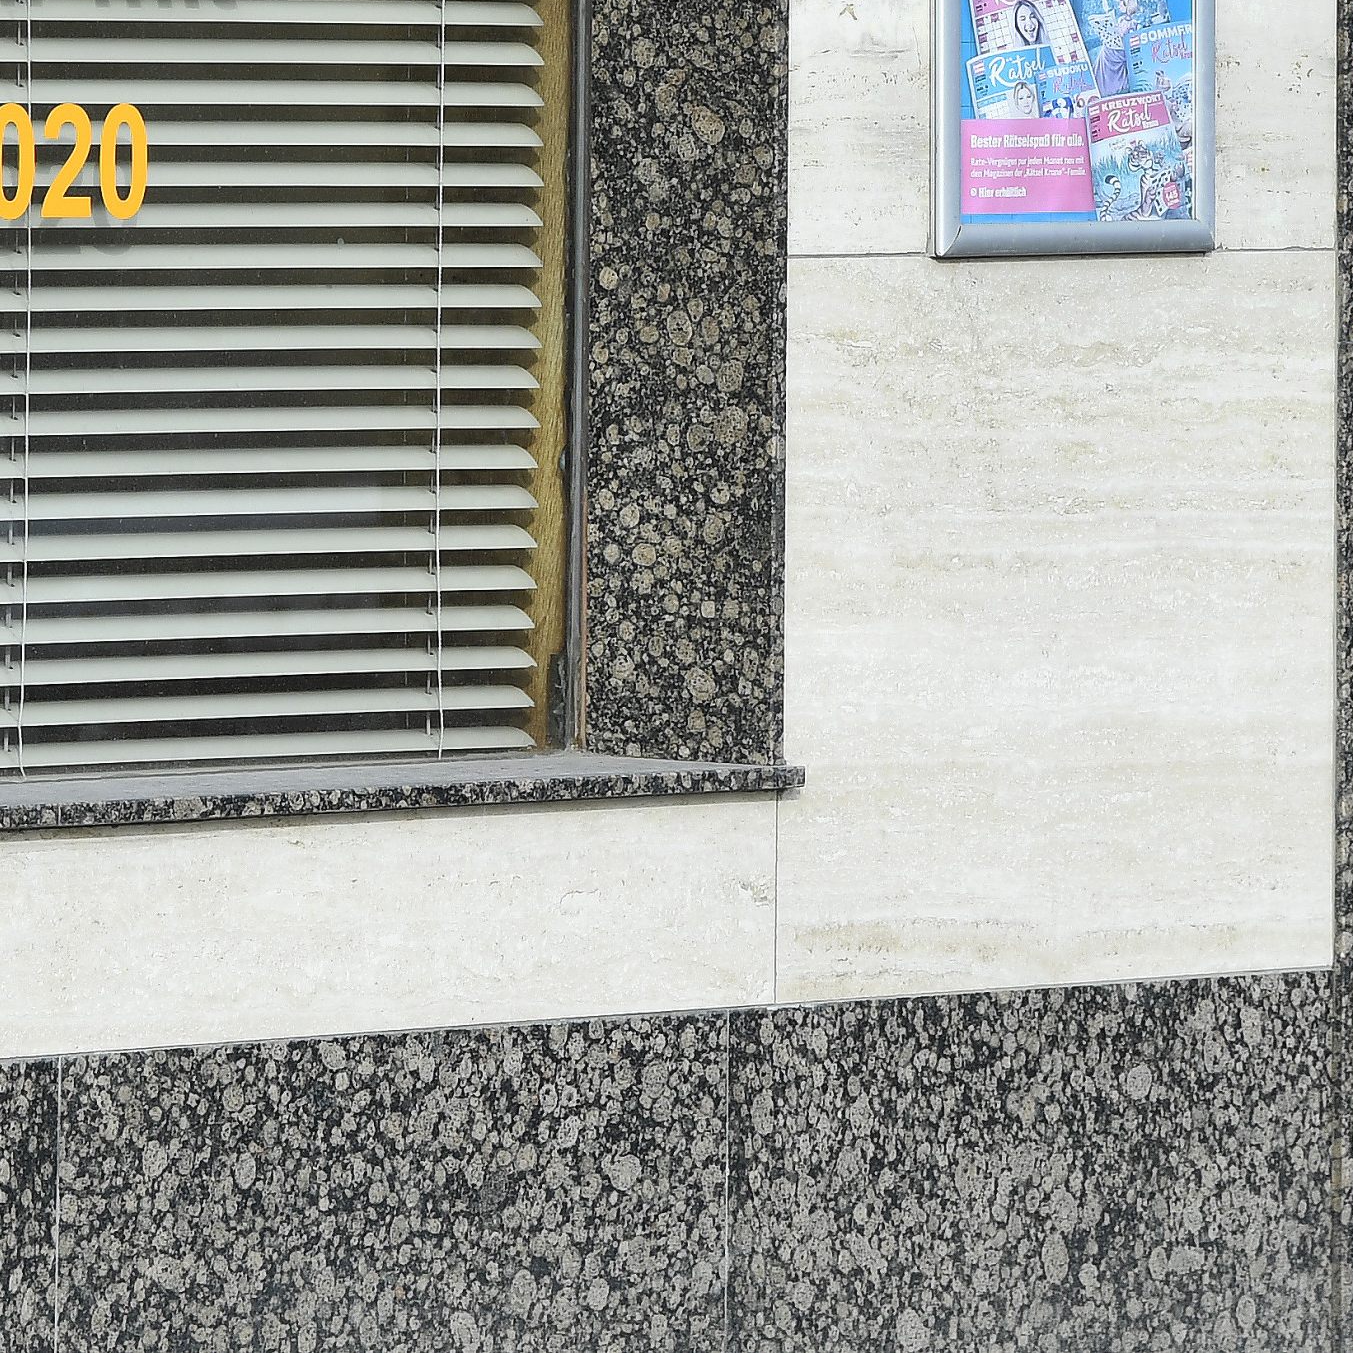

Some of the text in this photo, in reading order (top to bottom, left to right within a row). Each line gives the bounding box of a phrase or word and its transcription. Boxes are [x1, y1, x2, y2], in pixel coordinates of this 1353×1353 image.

[988, 47, 1045, 87] Rätsel
[1101, 93, 1162, 112] KREUZWORT
[970, 134, 1002, 148] Bester
[1051, 133, 1066, 147] für
[0, 102, 148, 220] 020
